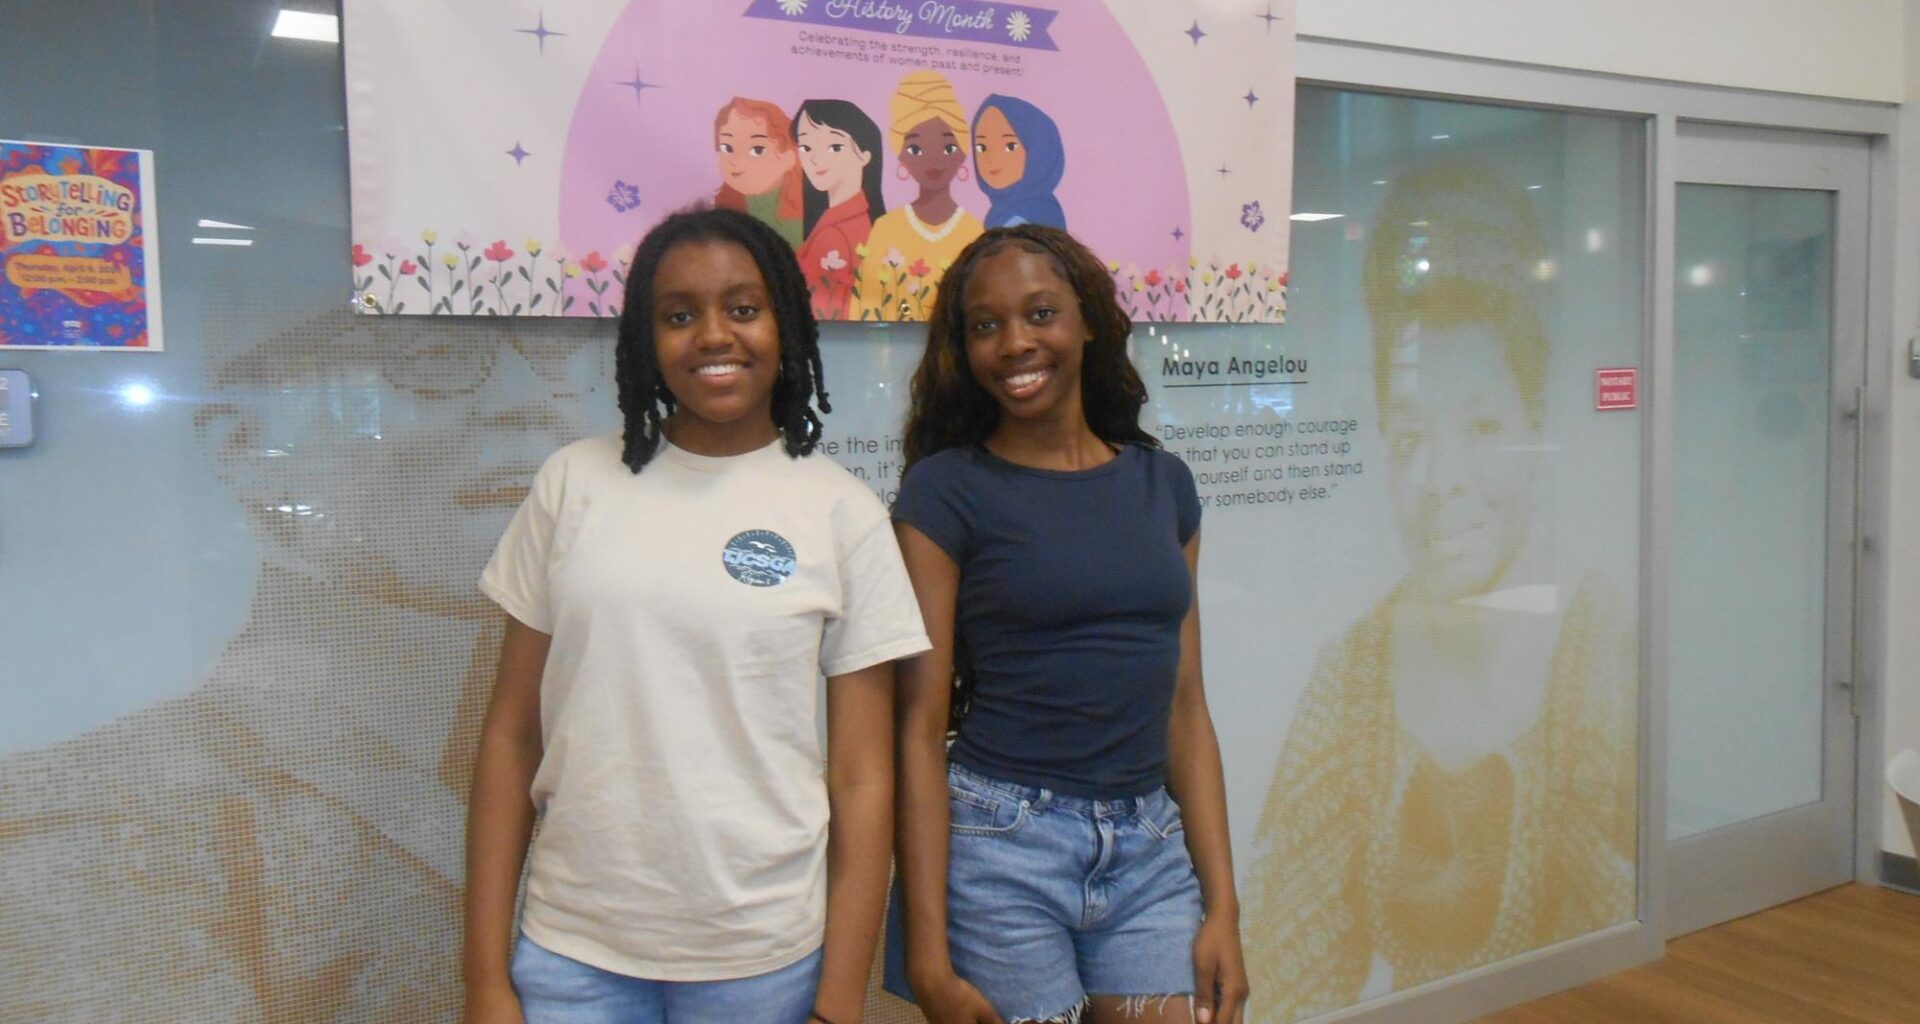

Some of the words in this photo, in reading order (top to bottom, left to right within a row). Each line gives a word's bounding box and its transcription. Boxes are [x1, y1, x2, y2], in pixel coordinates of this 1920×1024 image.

[825, 0, 912, 34] History
[918, 0, 995, 33] Month
[798, 30, 866, 50] Celebrating
[869, 40, 888, 51] the
[1003, 54, 1021, 63] and
[790, 45, 869, 62] achievements
[872, 53, 885, 63] of
[889, 56, 928, 67] women
[931, 60, 957, 70] past
[960, 61, 980, 71] and
[56, 202, 82, 217] for
[1162, 357, 1219, 380] Maya
[1227, 355, 1308, 378] Angelou
[1235, 420, 1292, 439] enough
[1297, 419, 1358, 436] courage
[846, 437, 879, 454] the
[1186, 446, 1217, 462] that
[1222, 448, 1250, 463] you
[1255, 445, 1284, 459] can
[1288, 440, 1328, 457] stand
[1332, 441, 1351, 457] up
[1253, 465, 1283, 481] and
[1288, 463, 1320, 479] then
[1323, 461, 1363, 477] stand
[1216, 487, 1295, 507] somebody
